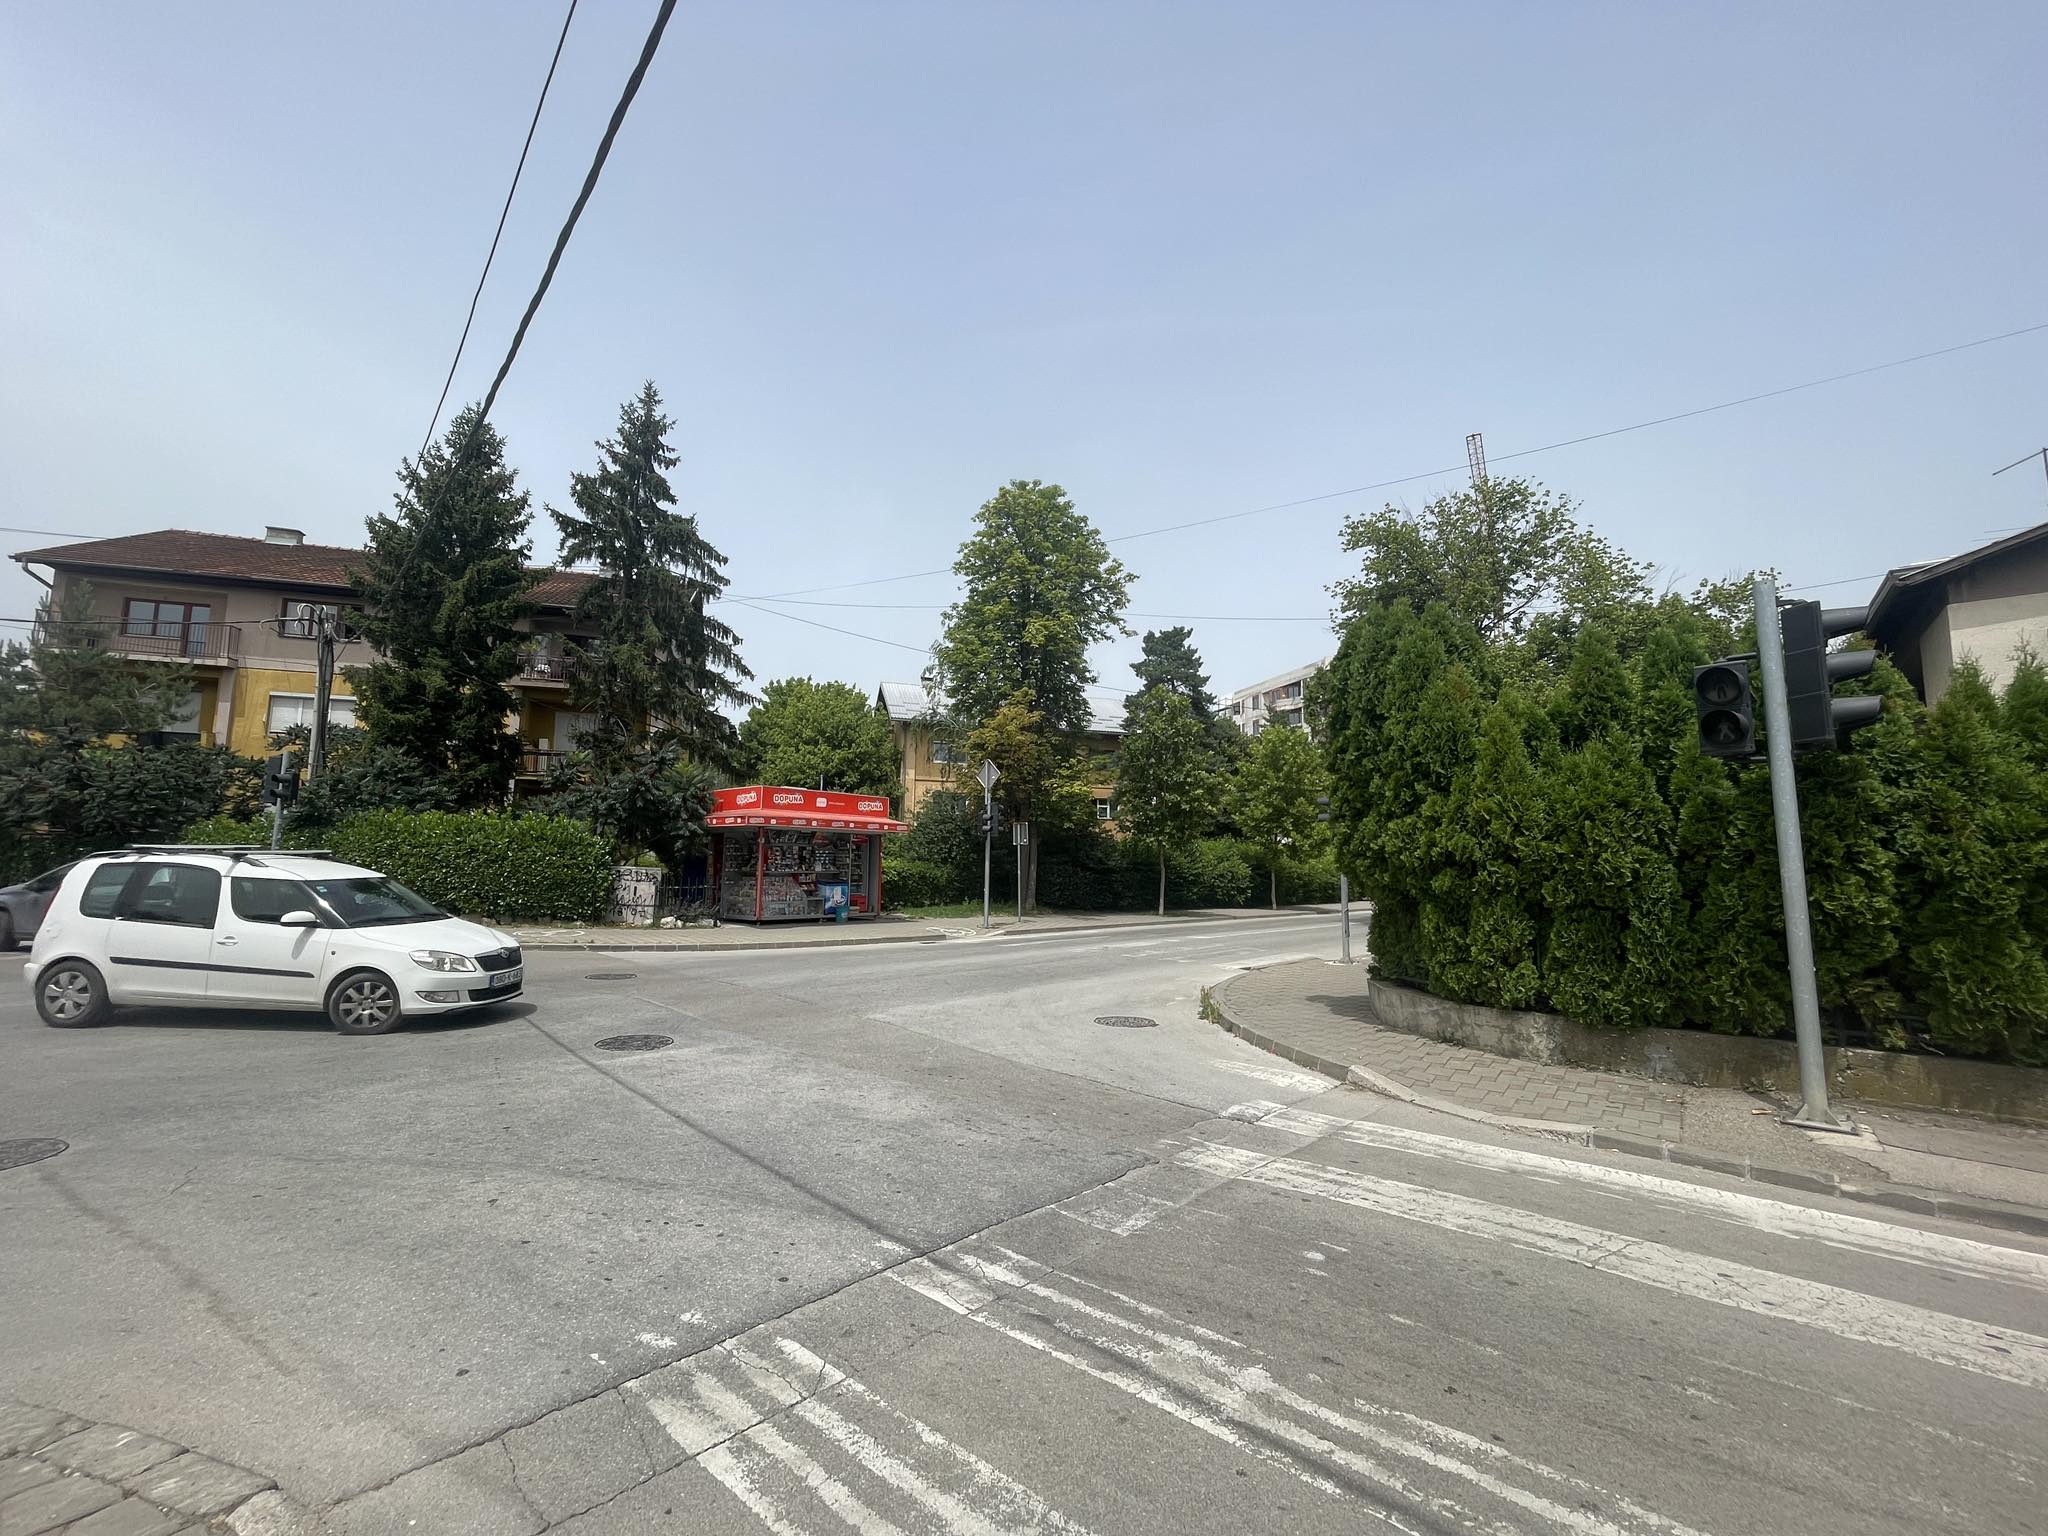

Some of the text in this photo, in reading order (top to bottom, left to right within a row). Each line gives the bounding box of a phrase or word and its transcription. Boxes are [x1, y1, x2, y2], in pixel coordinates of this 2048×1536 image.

[737, 792, 757, 803] DOPUNA
[774, 794, 804, 803] DOPUNA
[858, 802, 883, 811] DOPUNA
